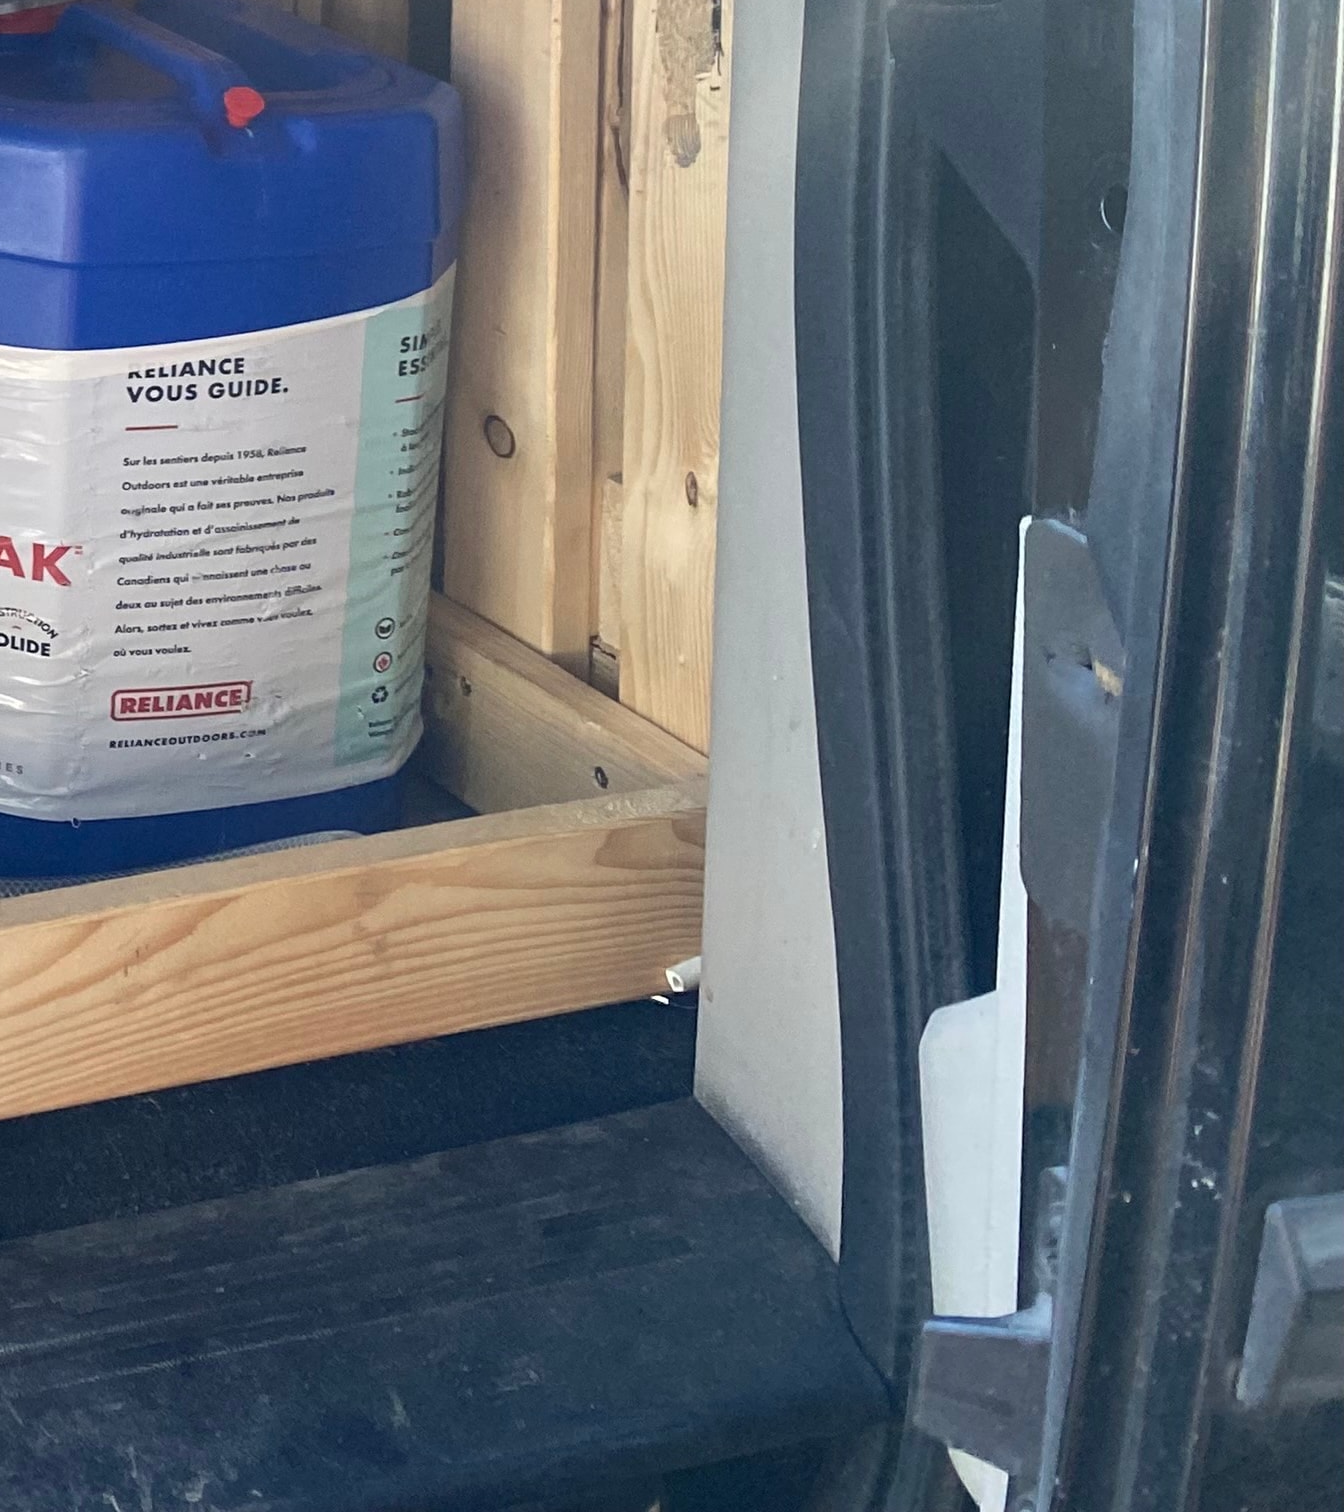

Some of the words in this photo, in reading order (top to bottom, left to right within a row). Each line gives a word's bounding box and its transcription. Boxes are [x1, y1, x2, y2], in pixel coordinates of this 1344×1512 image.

[126, 384, 198, 403] VOUS
[208, 377, 289, 400] GUIDE.
[122, 457, 140, 466] Sur
[143, 456, 157, 466] les
[160, 453, 199, 466] sentiers
[201, 450, 234, 464] depuis
[122, 480, 170, 492] Outdoors
[173, 480, 188, 489] est
[190, 479, 208, 488] une
[212, 473, 254, 486] véritable
[256, 468, 304, 484] entreprise
[169, 502, 186, 514] qui
[197, 500, 214, 511] fait
[216, 501, 232, 510] ses
[234, 496, 274, 511] preuves.
[277, 494, 296, 504] Nos
[298, 488, 336, 504] produits
[192, 526, 202, 536] et
[288, 516, 300, 525] de
[118, 552, 154, 566] qualité
[156, 548, 210, 561] industrielle
[213, 546, 234, 556] sont
[235, 542, 280, 556] fabriqués
[282, 540, 299, 552] par
[301, 536, 318, 547] des
[117, 574, 170, 586] Canadiens
[173, 574, 190, 585] qui
[192, 568, 248, 582] nnaissent
[250, 568, 268, 578] une
[115, 600, 142, 610] deux
[144, 599, 158, 608] au
[160, 596, 184, 610] sujet
[185, 595, 204, 606] des
[114, 624, 144, 635] Alors,
[147, 622, 178, 632] sortez
[180, 621, 190, 630] et
[192, 619, 218, 630] vivez
[220, 618, 254, 626] comme
[113, 648, 126, 657] où
[129, 648, 152, 656] vous
[120, 688, 244, 714] RELIANCE
[109, 728, 267, 749] RELIANCEOUTDOORS.COM
